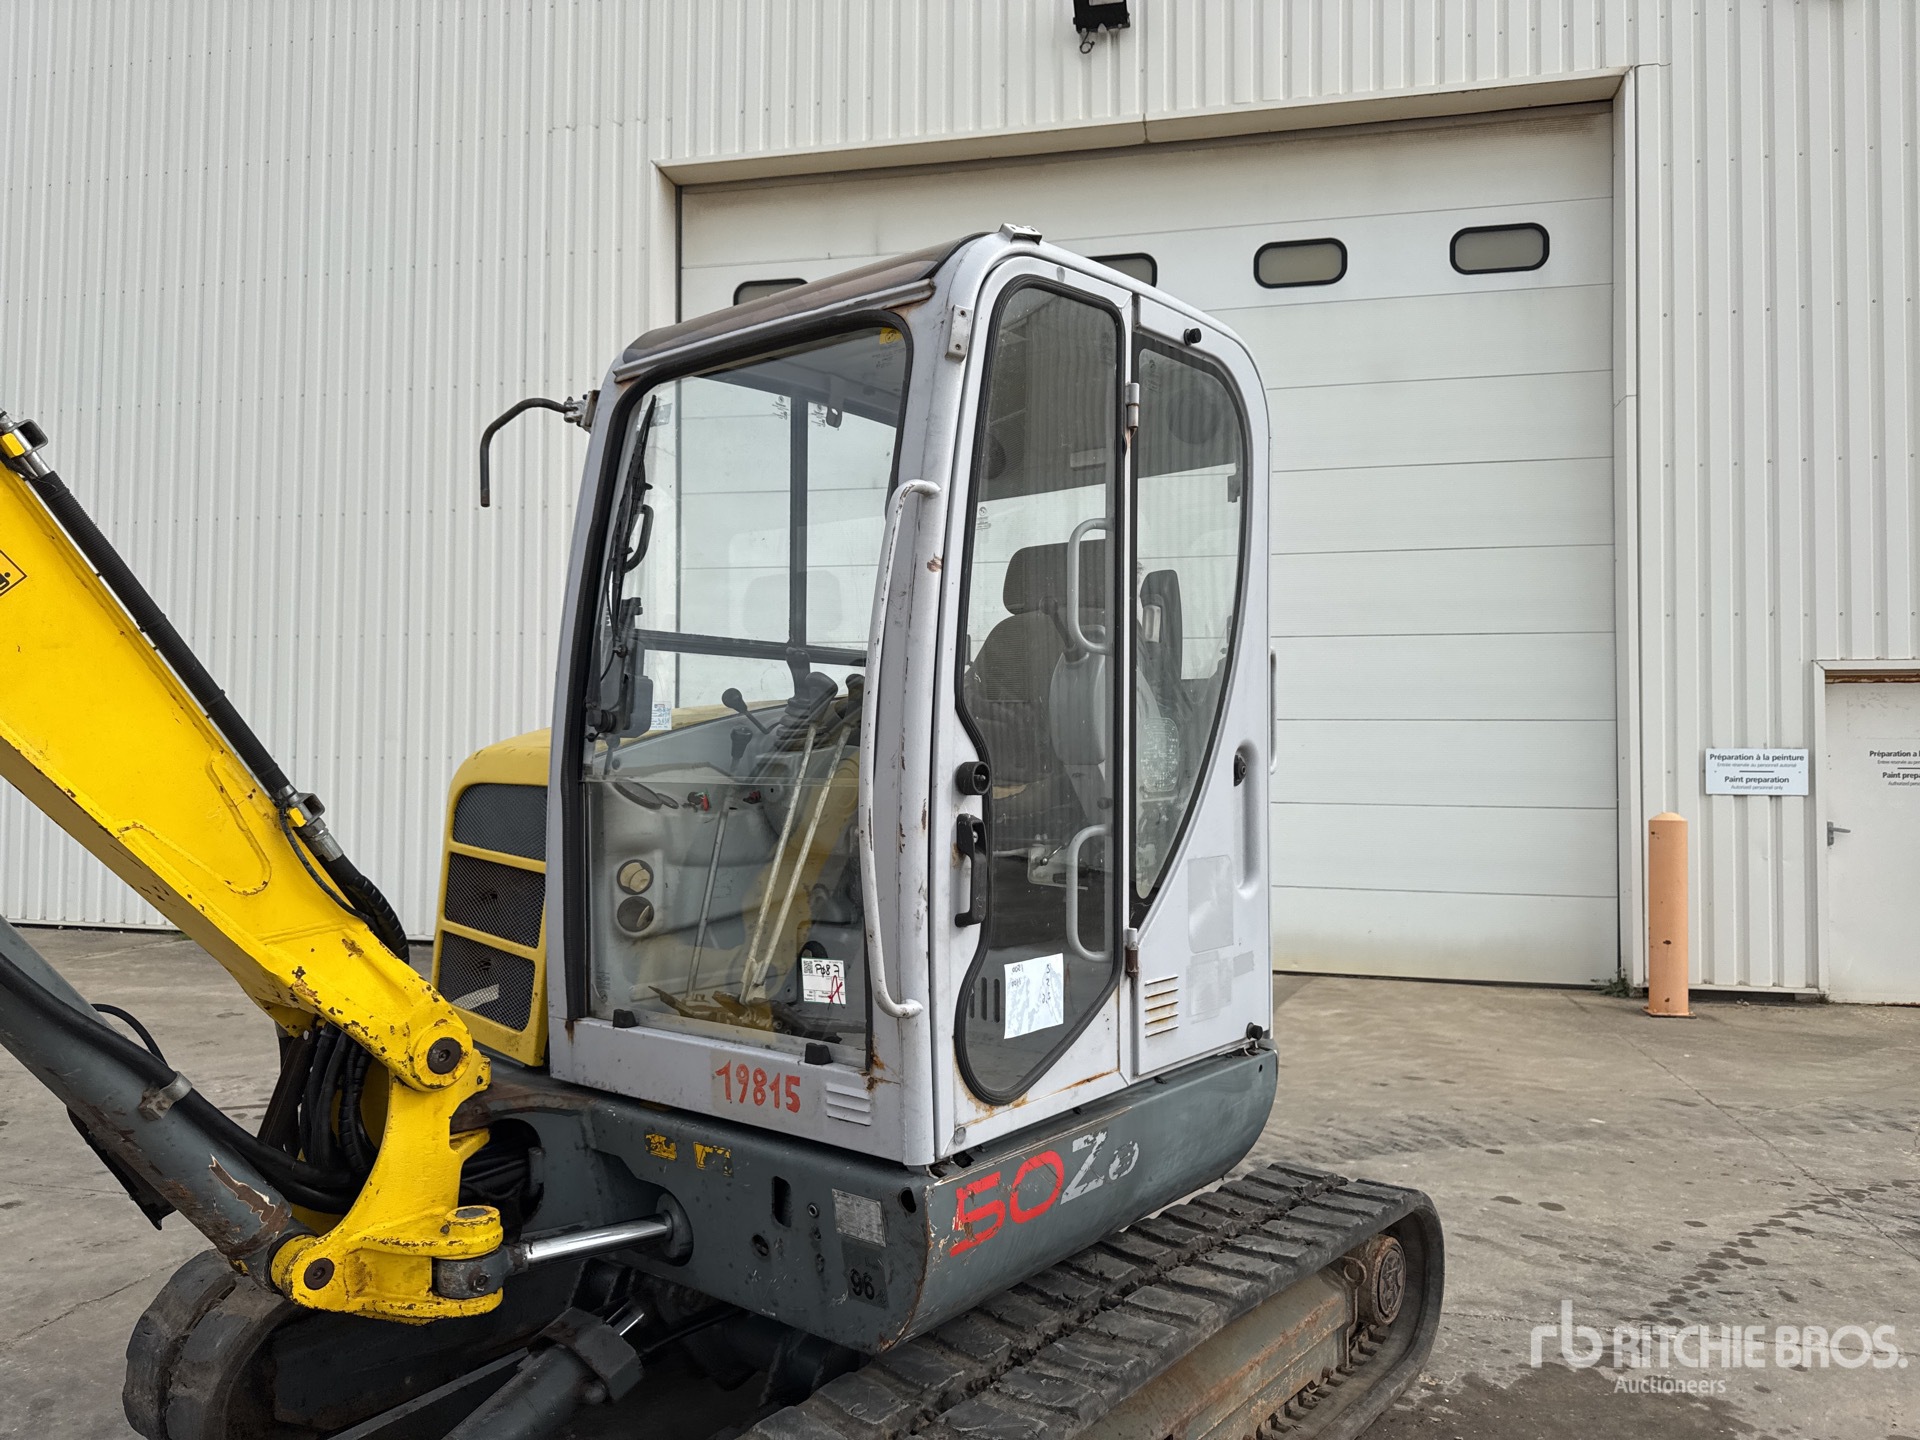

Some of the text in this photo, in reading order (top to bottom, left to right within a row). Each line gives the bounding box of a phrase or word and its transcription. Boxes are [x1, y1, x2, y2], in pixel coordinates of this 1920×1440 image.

[1709, 753, 1805, 762] Préparation à la peinture
[1882, 771, 1901, 779] Paint
[1745, 776, 1790, 784] preparation
[715, 1060, 801, 1113] 19815
[850, 1268, 875, 1300] 96
